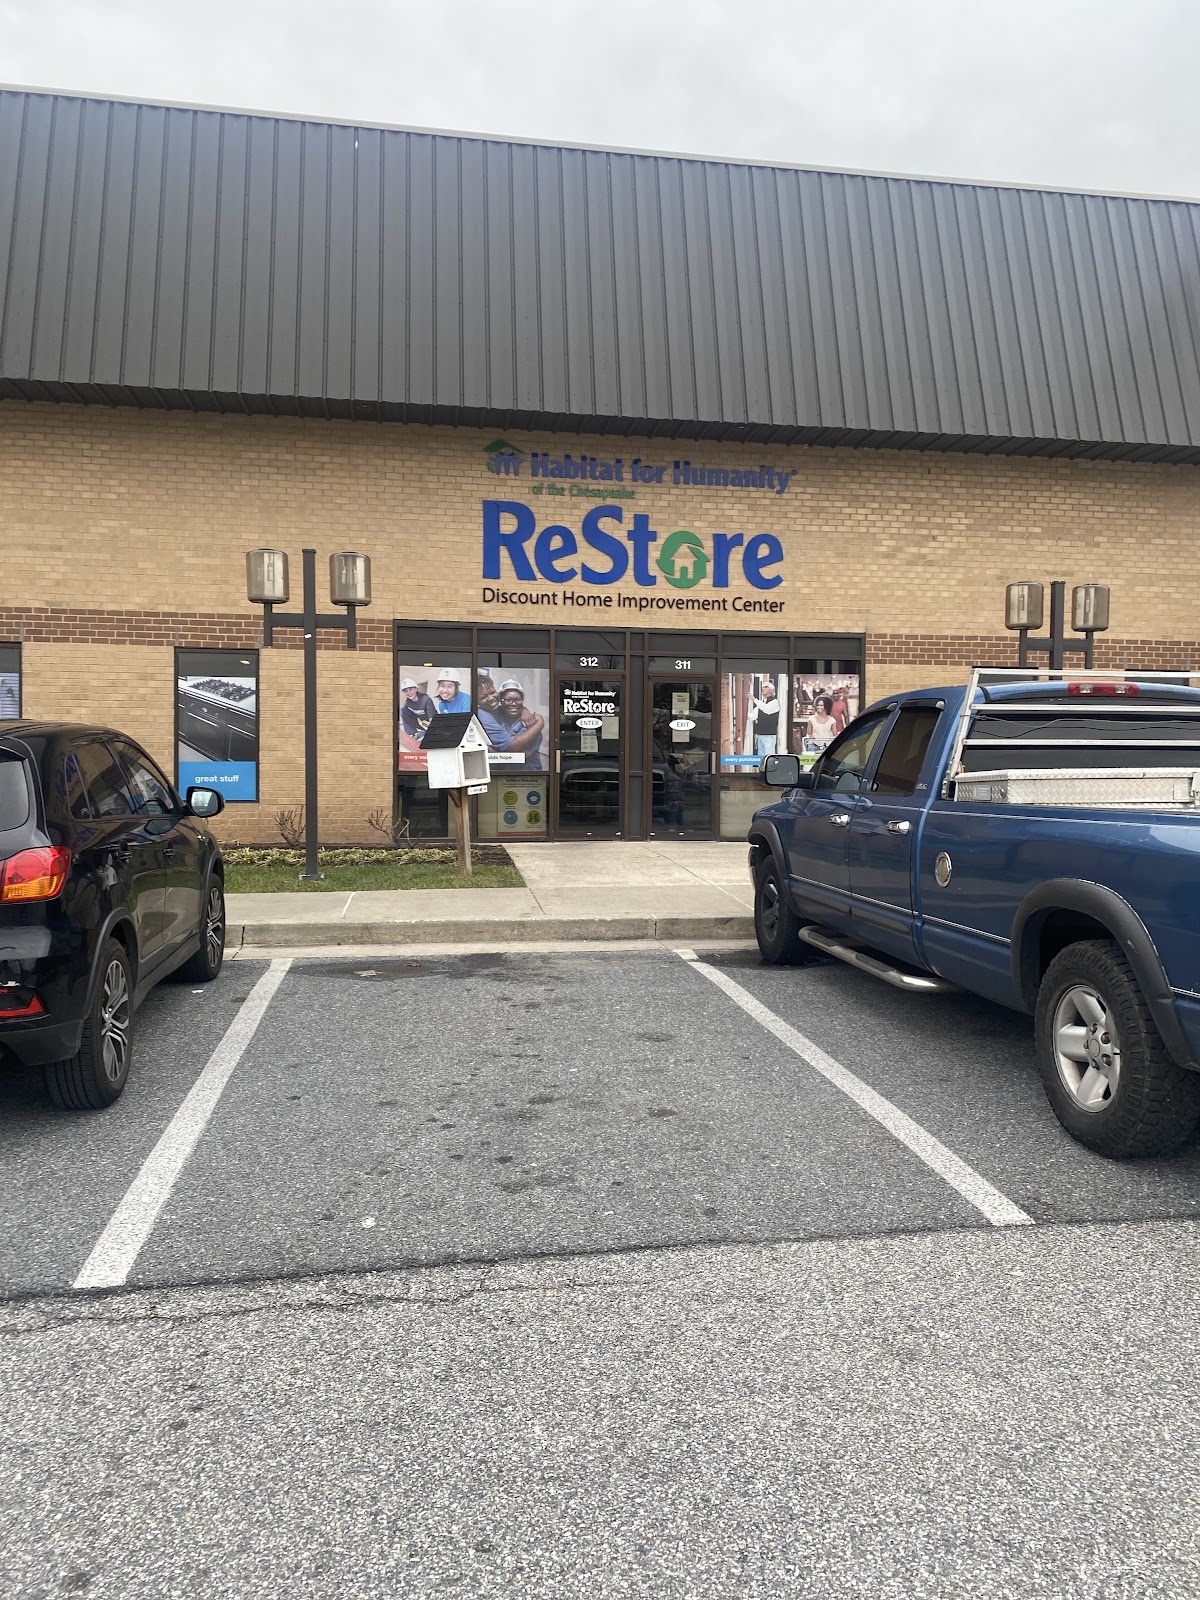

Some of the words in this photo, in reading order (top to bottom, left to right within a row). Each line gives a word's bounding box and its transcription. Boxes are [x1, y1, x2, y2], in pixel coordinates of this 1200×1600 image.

[531, 452, 624, 482] Habitat
[631, 458, 667, 484] for
[532, 482, 545, 495] of
[547, 482, 566, 497] the
[568, 482, 636, 501] Chesapeake
[482, 499, 785, 590] ReStore
[482, 587, 558, 606] Discount
[563, 590, 613, 609] Home
[617, 592, 728, 614] Improvement
[732, 597, 786, 613] Center
[579, 656, 599, 667] 312
[675, 659, 691, 670] 311
[563, 698, 616, 713] ReStore
[194, 775, 218, 784] great
[219, 774, 240, 783] stuff
